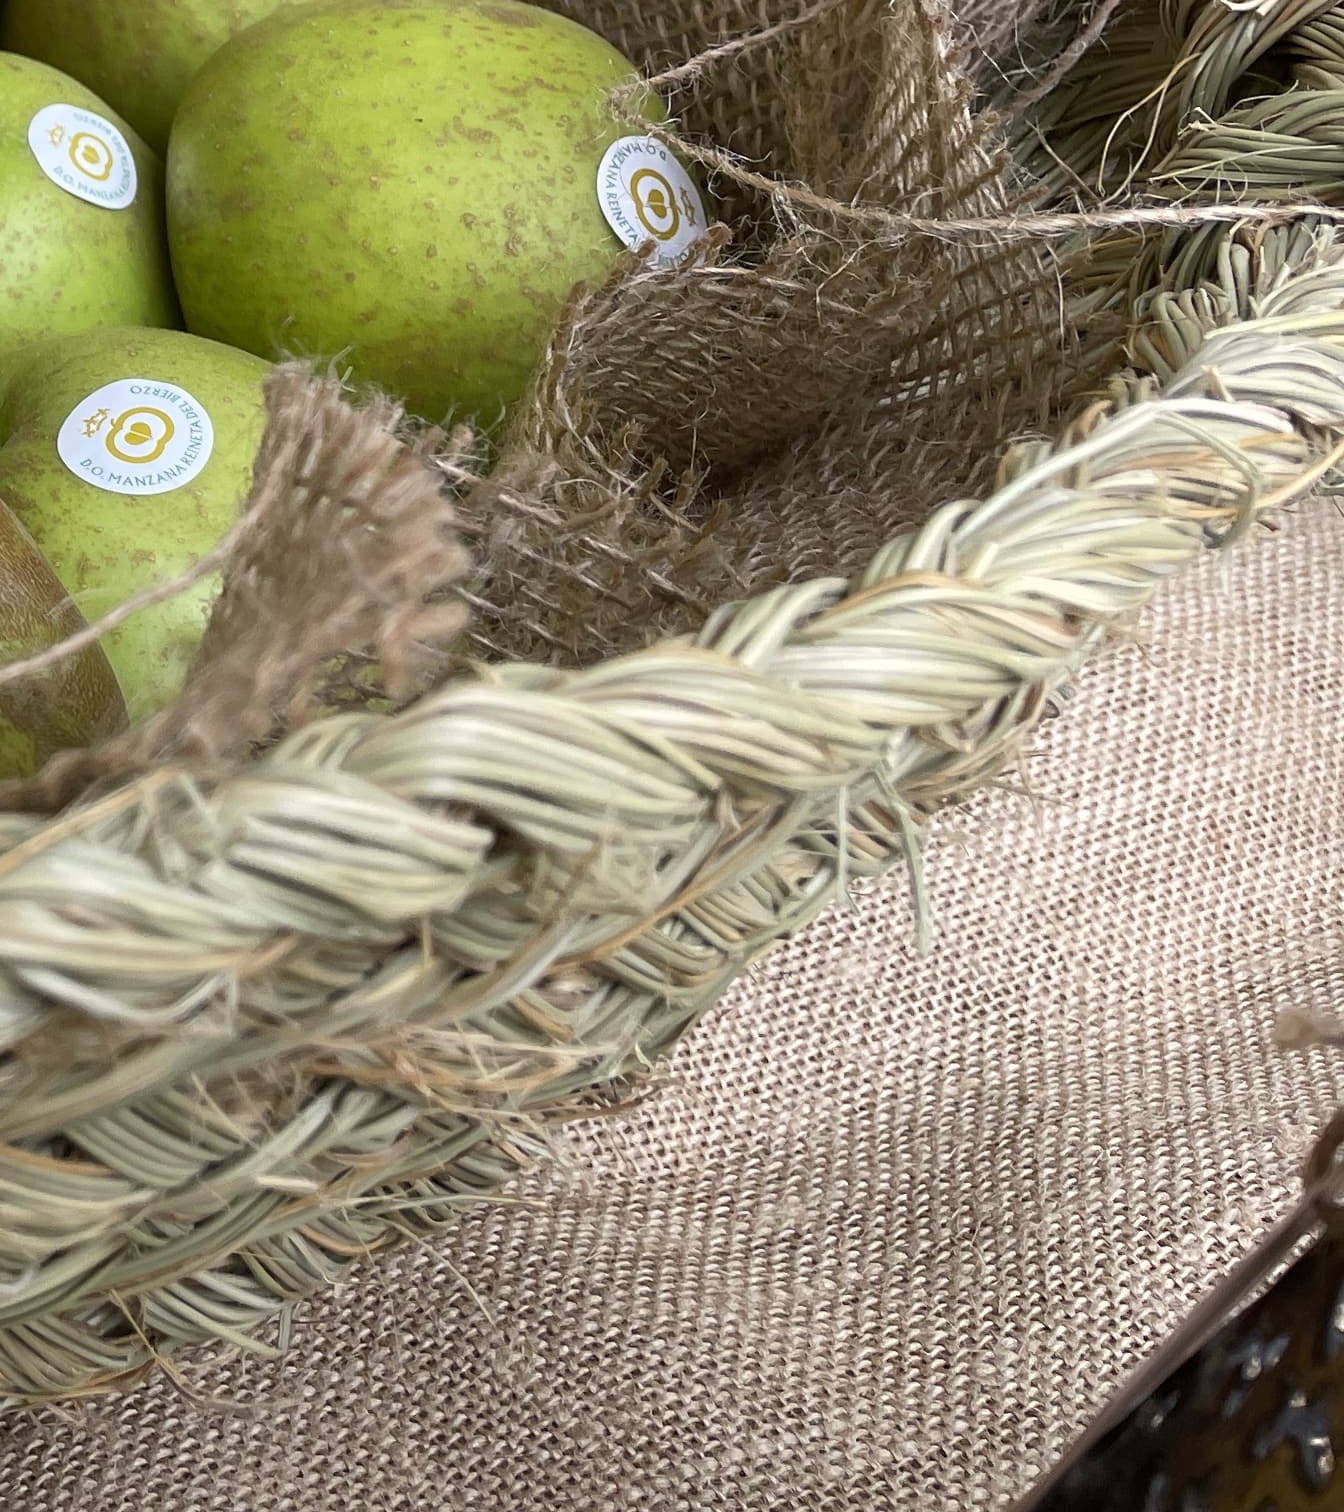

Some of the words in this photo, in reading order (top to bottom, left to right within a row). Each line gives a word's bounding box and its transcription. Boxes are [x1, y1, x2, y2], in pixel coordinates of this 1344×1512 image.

[605, 143, 643, 189] MANZANA
[606, 191, 639, 242] REINETA
[130, 385, 181, 404] BIERZO
[177, 398, 199, 420] DEL
[183, 419, 203, 467] REINETA
[80, 458, 105, 480] D.O.
[108, 464, 187, 487] MANZANA
